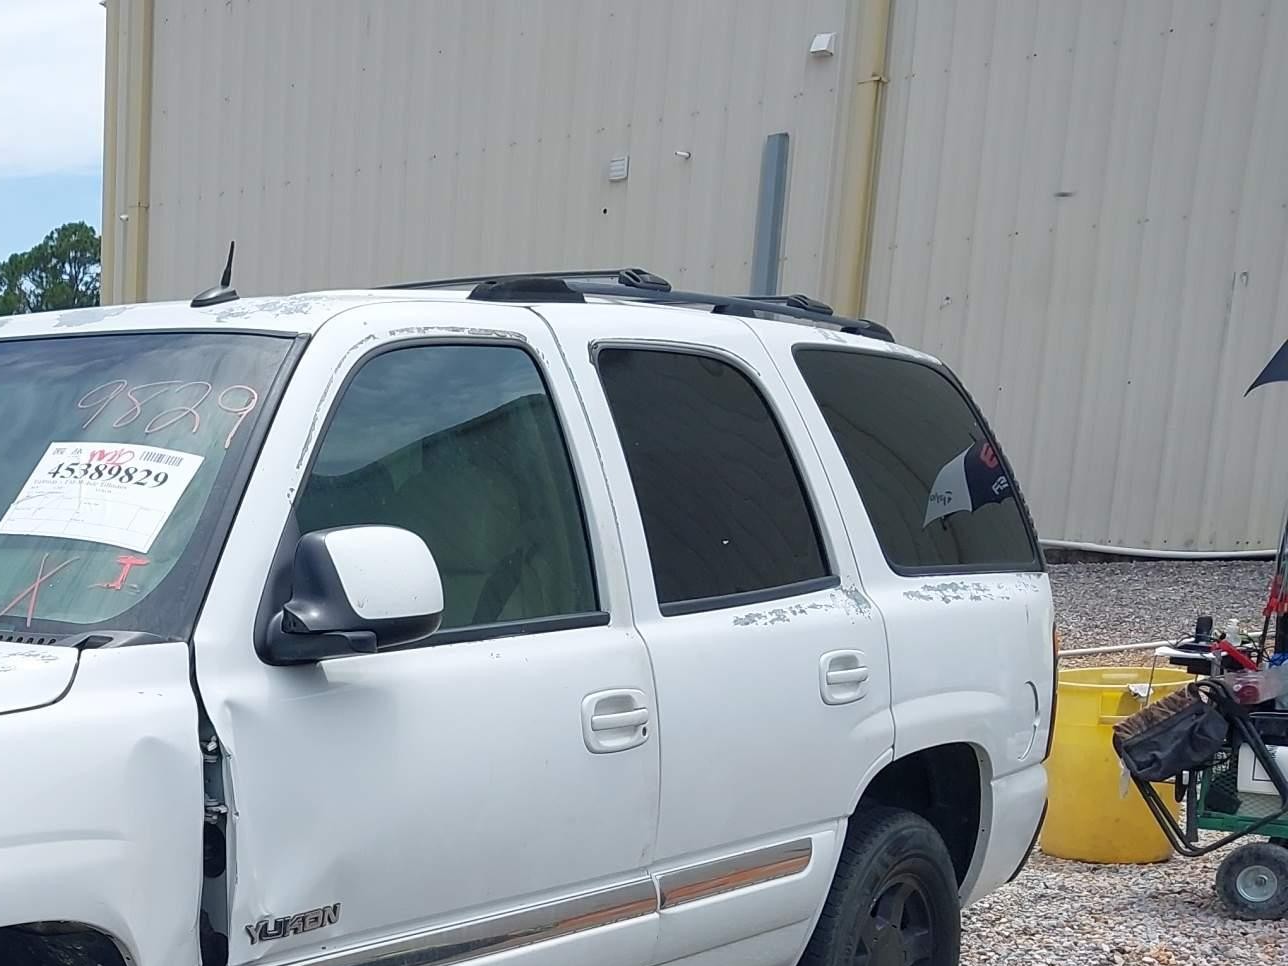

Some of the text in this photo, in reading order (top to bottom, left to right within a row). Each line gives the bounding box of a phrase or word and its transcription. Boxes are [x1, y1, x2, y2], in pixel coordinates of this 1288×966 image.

[78, 379, 258, 449] 9829
[47, 461, 169, 489] 45389829
[244, 902, 341, 945] YUKON
